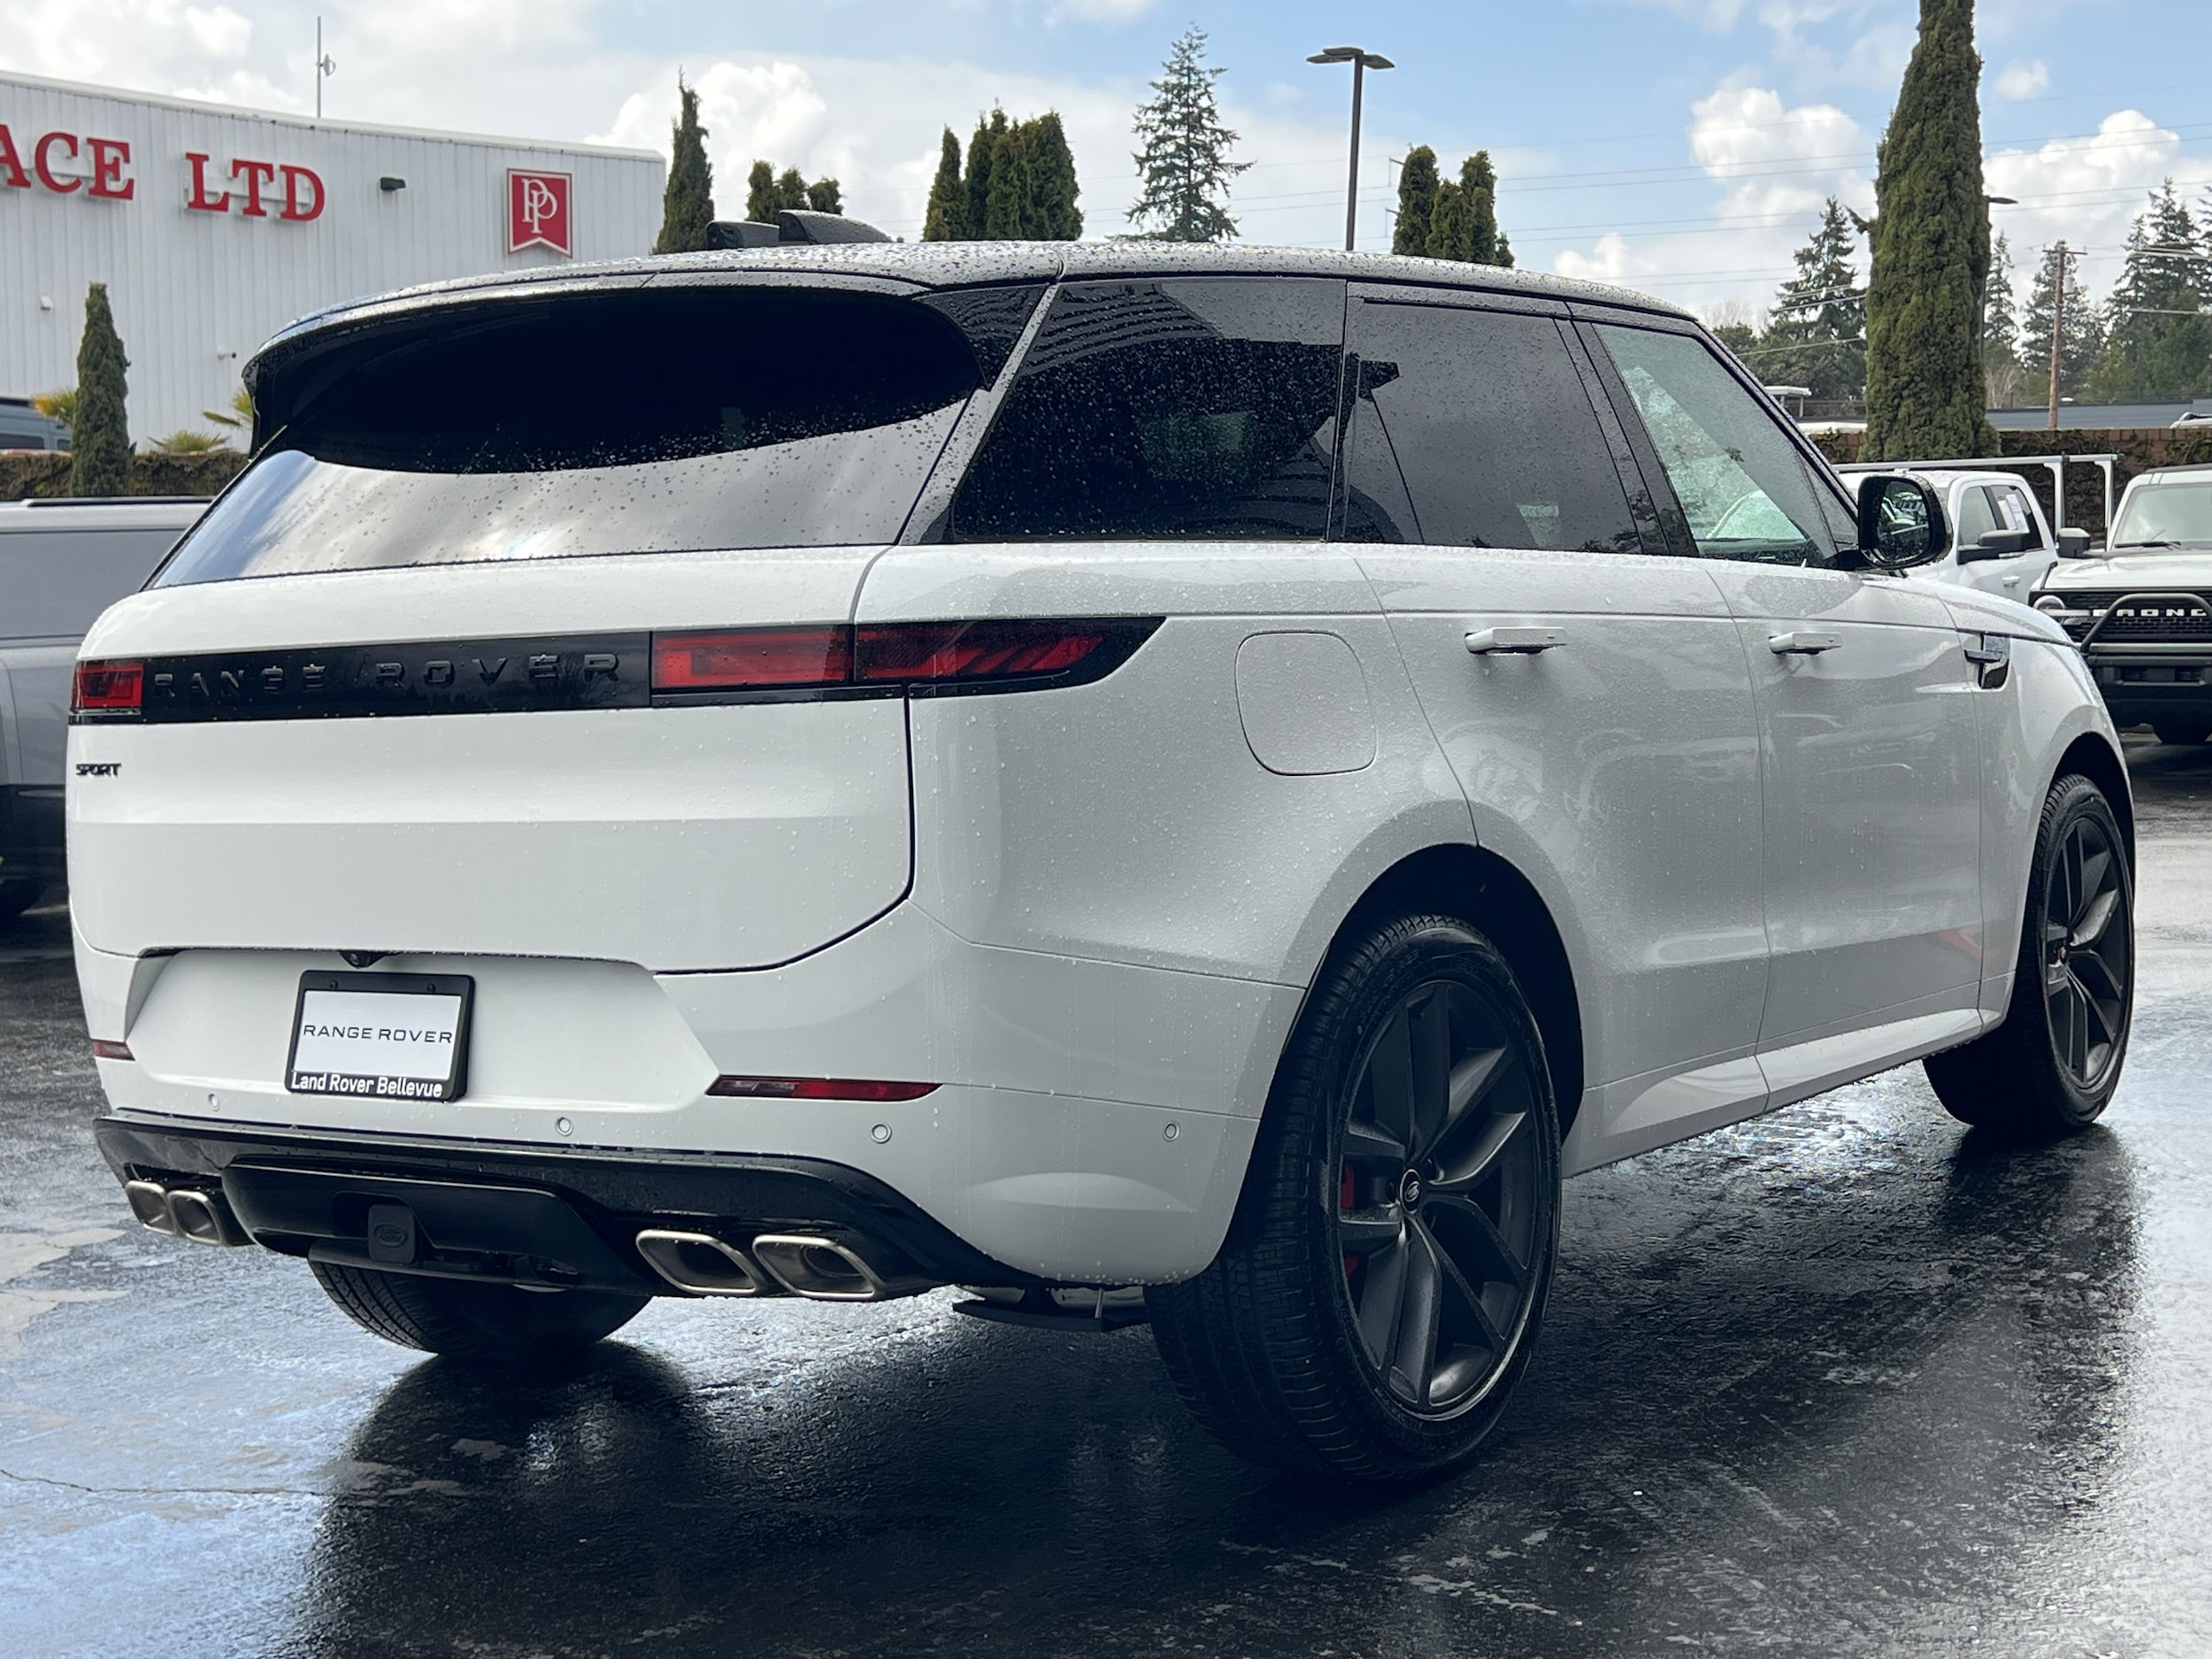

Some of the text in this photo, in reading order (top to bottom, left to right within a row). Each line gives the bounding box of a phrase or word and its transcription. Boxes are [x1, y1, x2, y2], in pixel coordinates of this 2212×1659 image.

[185, 151, 326, 220] LTD
[153, 653, 619, 702] RANGE ROVER
[76, 763, 122, 777] SPORT
[303, 1025, 453, 1043] RANGE ROVER
[291, 1071, 443, 1098] Land Rover Bellevue
